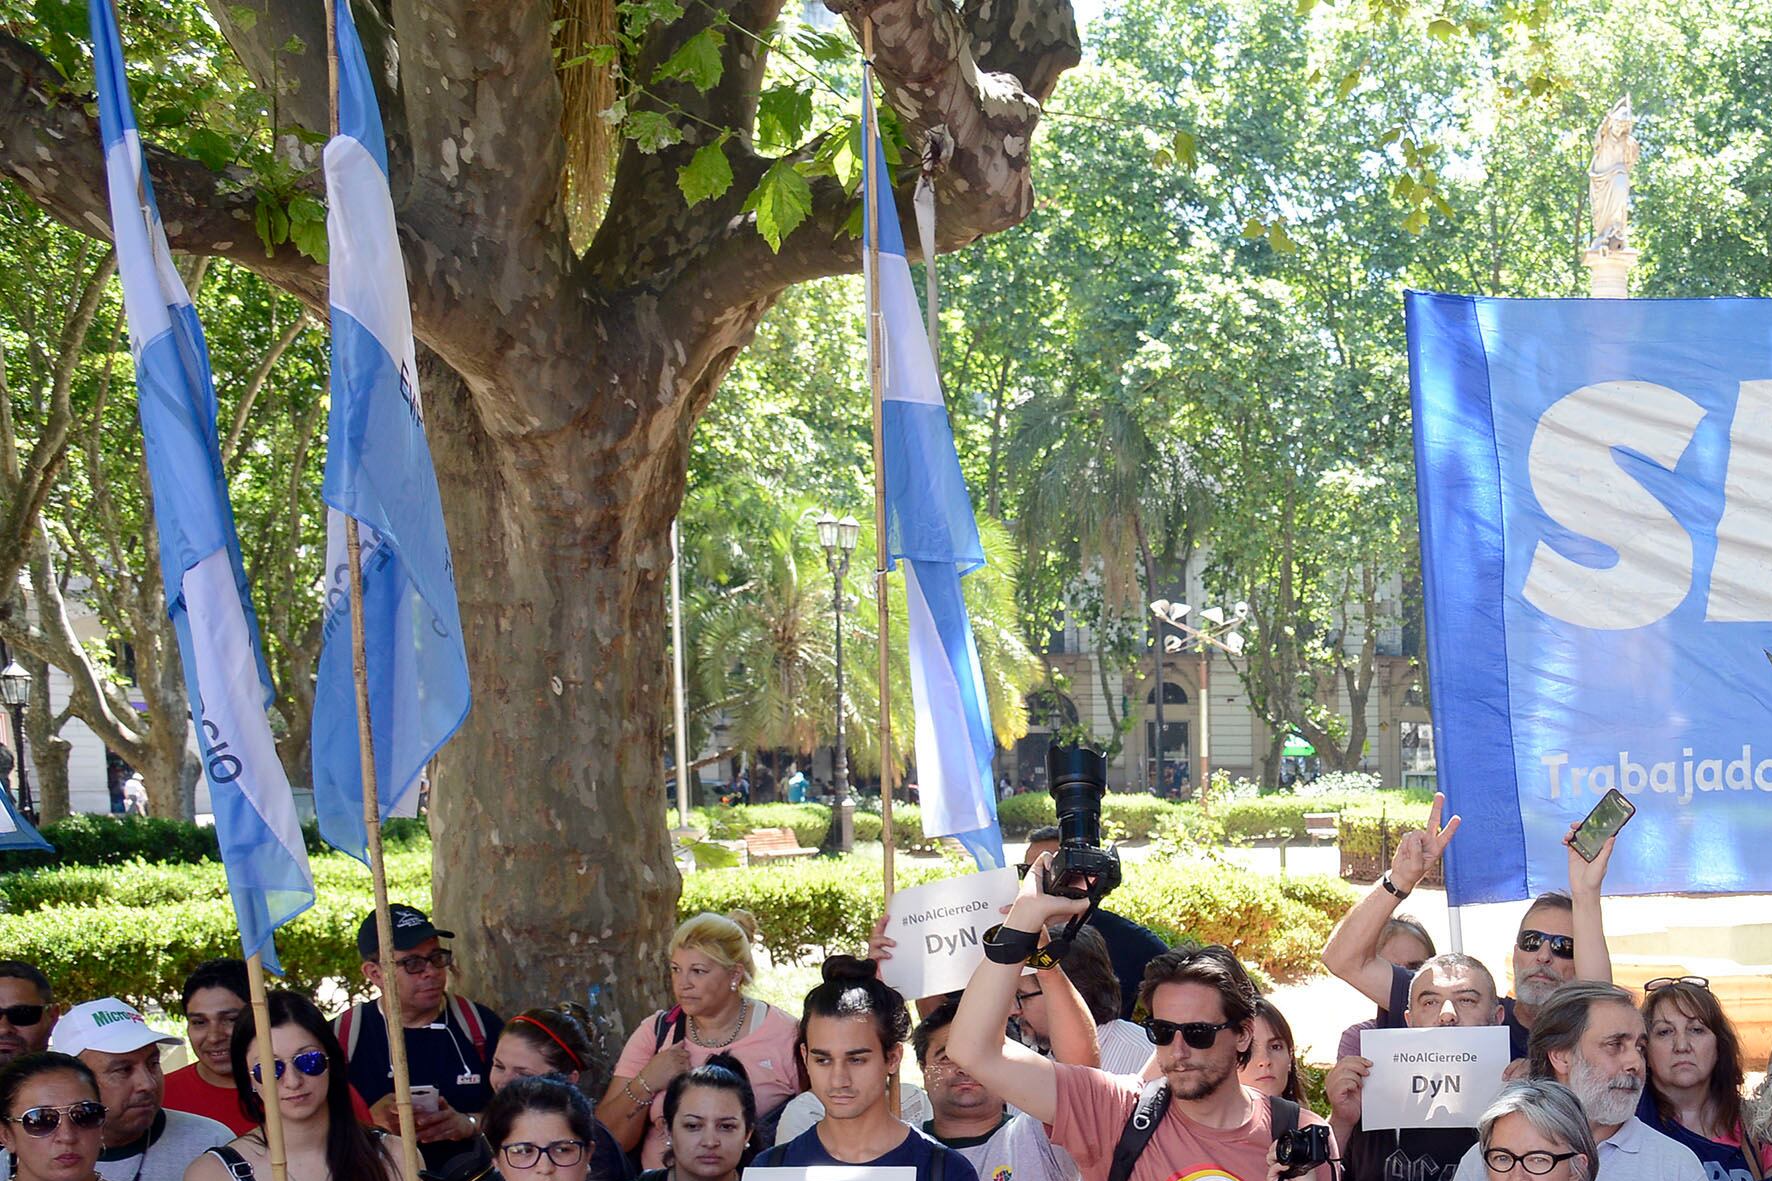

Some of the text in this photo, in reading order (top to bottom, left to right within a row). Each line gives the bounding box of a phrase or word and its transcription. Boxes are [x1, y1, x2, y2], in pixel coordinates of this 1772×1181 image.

[902, 900, 989, 927] #NoAlCierreDe
[925, 926, 979, 956] DyN
[1393, 1052, 1477, 1063] #NoAlCierreDe
[1412, 1075, 1461, 1098] DyN
